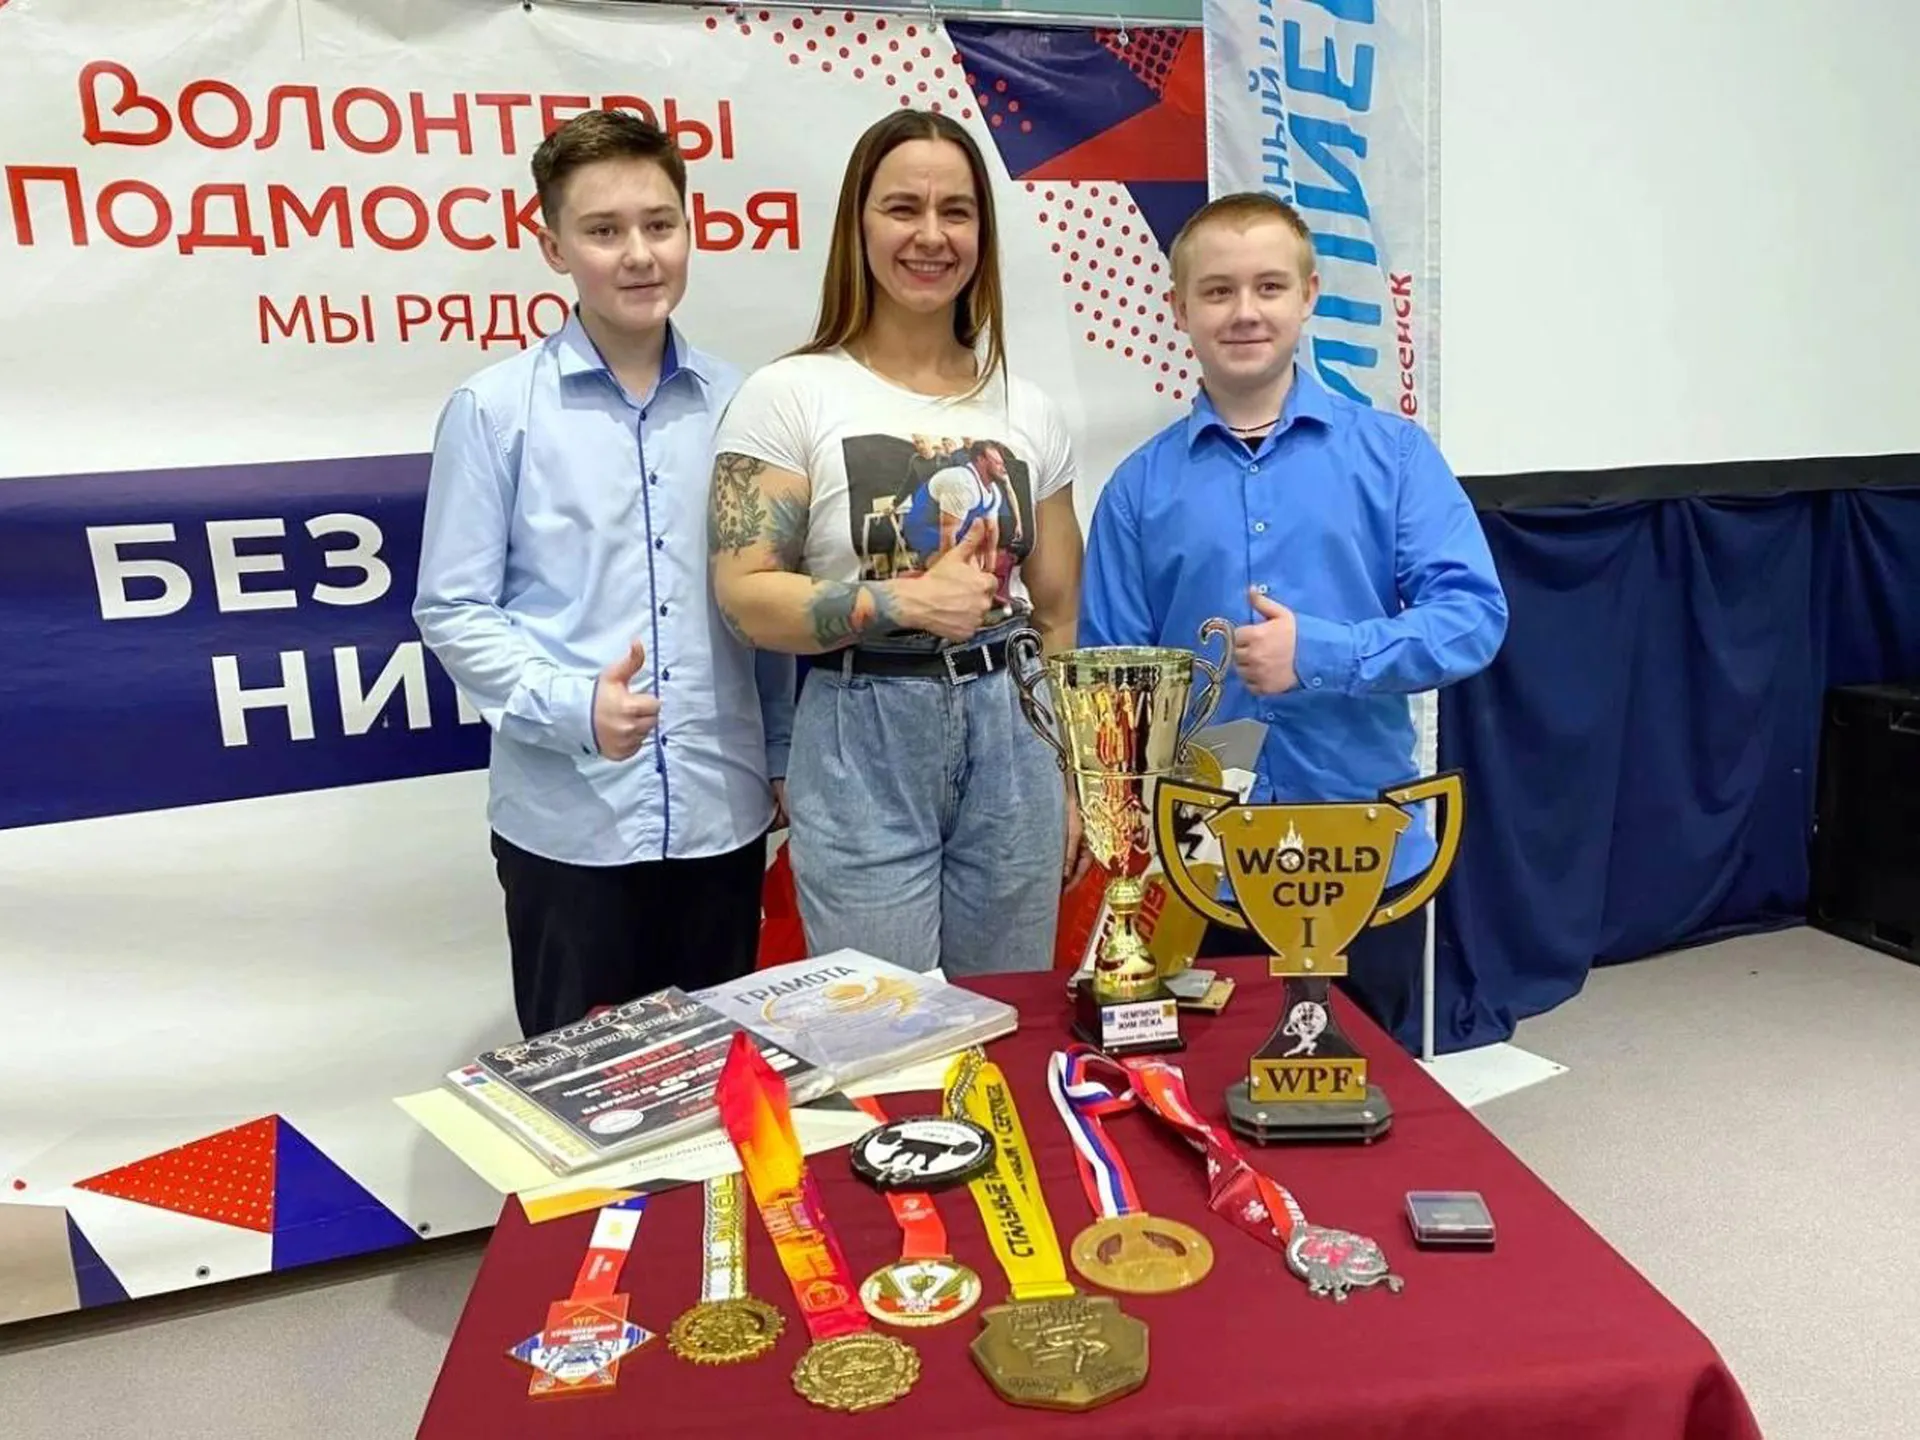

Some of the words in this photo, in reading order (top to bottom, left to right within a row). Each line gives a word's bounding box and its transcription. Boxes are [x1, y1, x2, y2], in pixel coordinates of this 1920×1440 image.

[5, 165, 801, 256] ПОДМОСКЬЯ
[258, 294, 377, 344] МЫ
[396, 291, 570, 351] РЯДО
[1389, 272, 1418, 423] есенск
[86, 512, 392, 620] БЕЗ
[211, 640, 486, 748] НИ
[1236, 845, 1381, 875] WORLD
[1272, 881, 1345, 908] CUP
[733, 965, 860, 1006] ГРАМОТА
[1118, 1020, 1138, 1031] ЖИМ
[1119, 1007, 1160, 1020] ЧЕМПИОН
[1263, 1066, 1353, 1093] WPF
